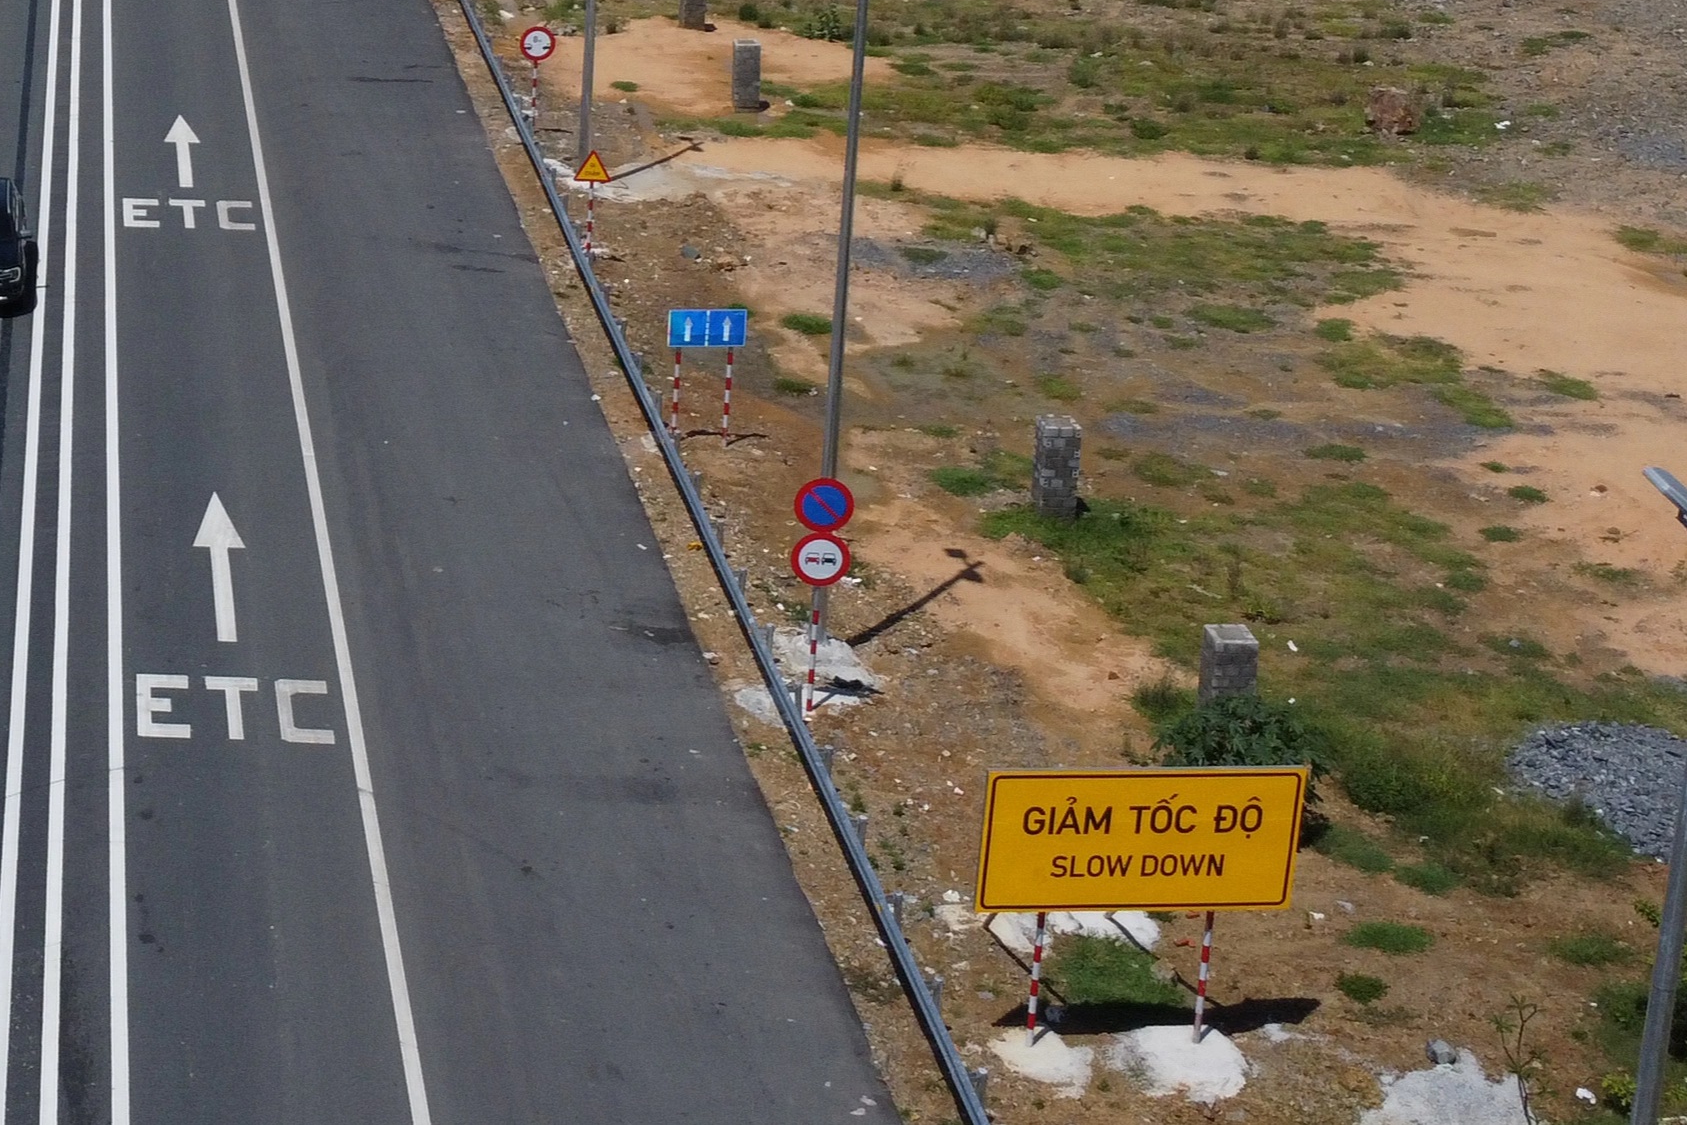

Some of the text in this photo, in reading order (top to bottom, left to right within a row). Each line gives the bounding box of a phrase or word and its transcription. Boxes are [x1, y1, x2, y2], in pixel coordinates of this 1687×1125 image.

[122, 197, 256, 231] ETC
[136, 673, 336, 745] ETC
[1022, 793, 1263, 839] GIẢM TỐC ĐỘ
[1050, 853, 1226, 878] SLOW DOWN
